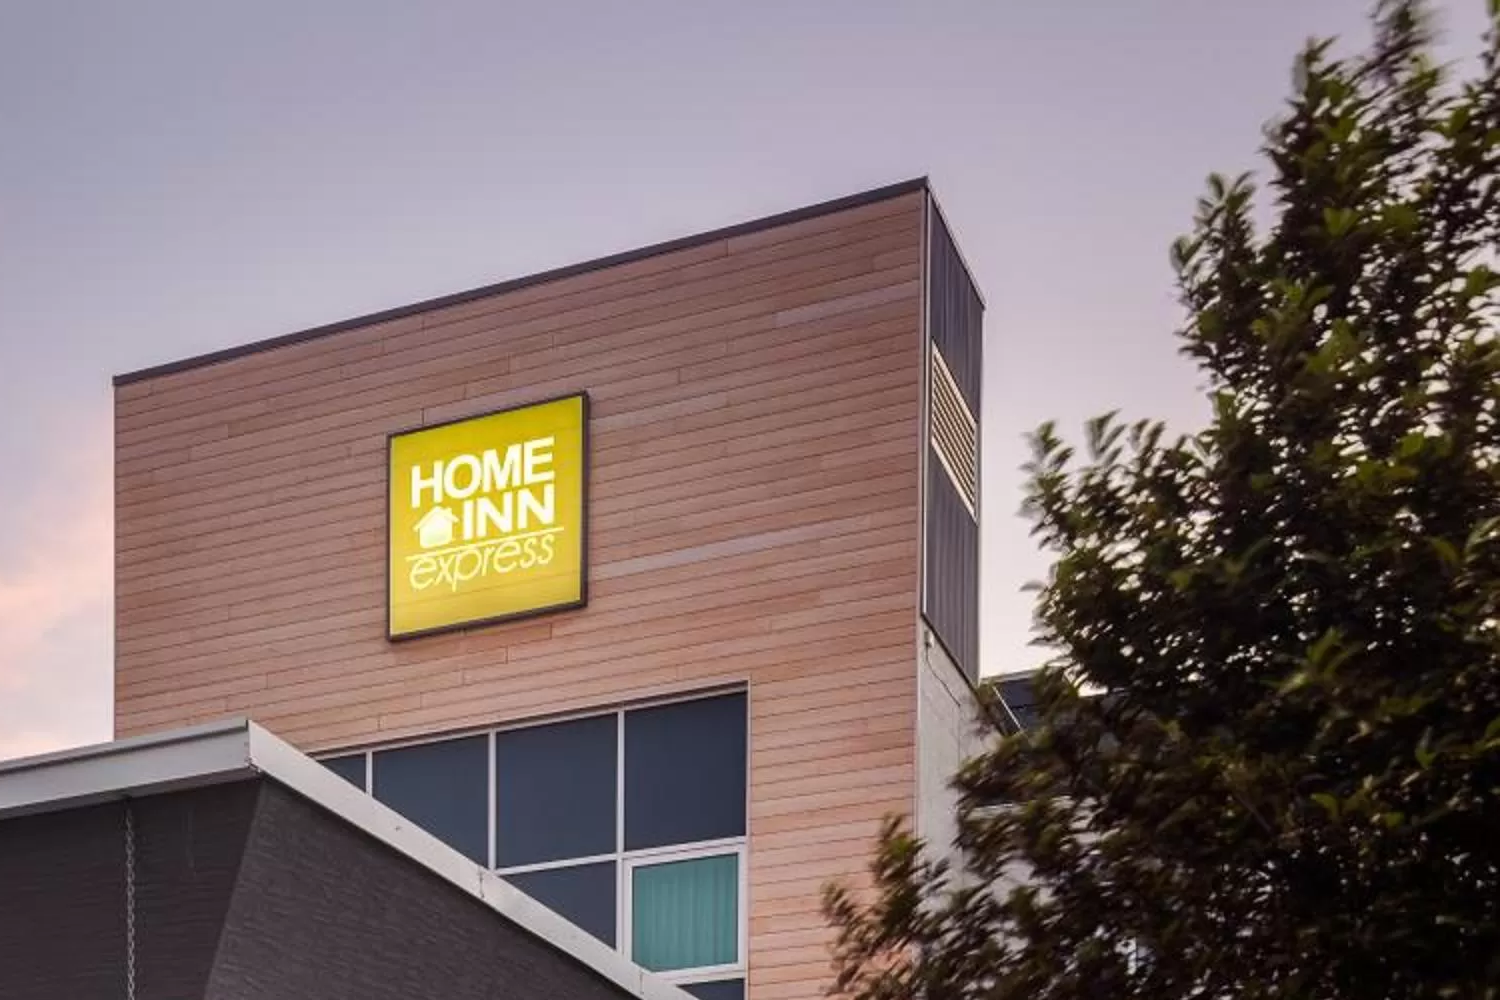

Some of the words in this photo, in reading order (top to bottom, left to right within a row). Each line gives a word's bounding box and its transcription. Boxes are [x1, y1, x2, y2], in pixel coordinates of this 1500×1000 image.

[411, 435, 556, 508] HOME
[462, 483, 556, 540] INN
[409, 533, 556, 592] express
